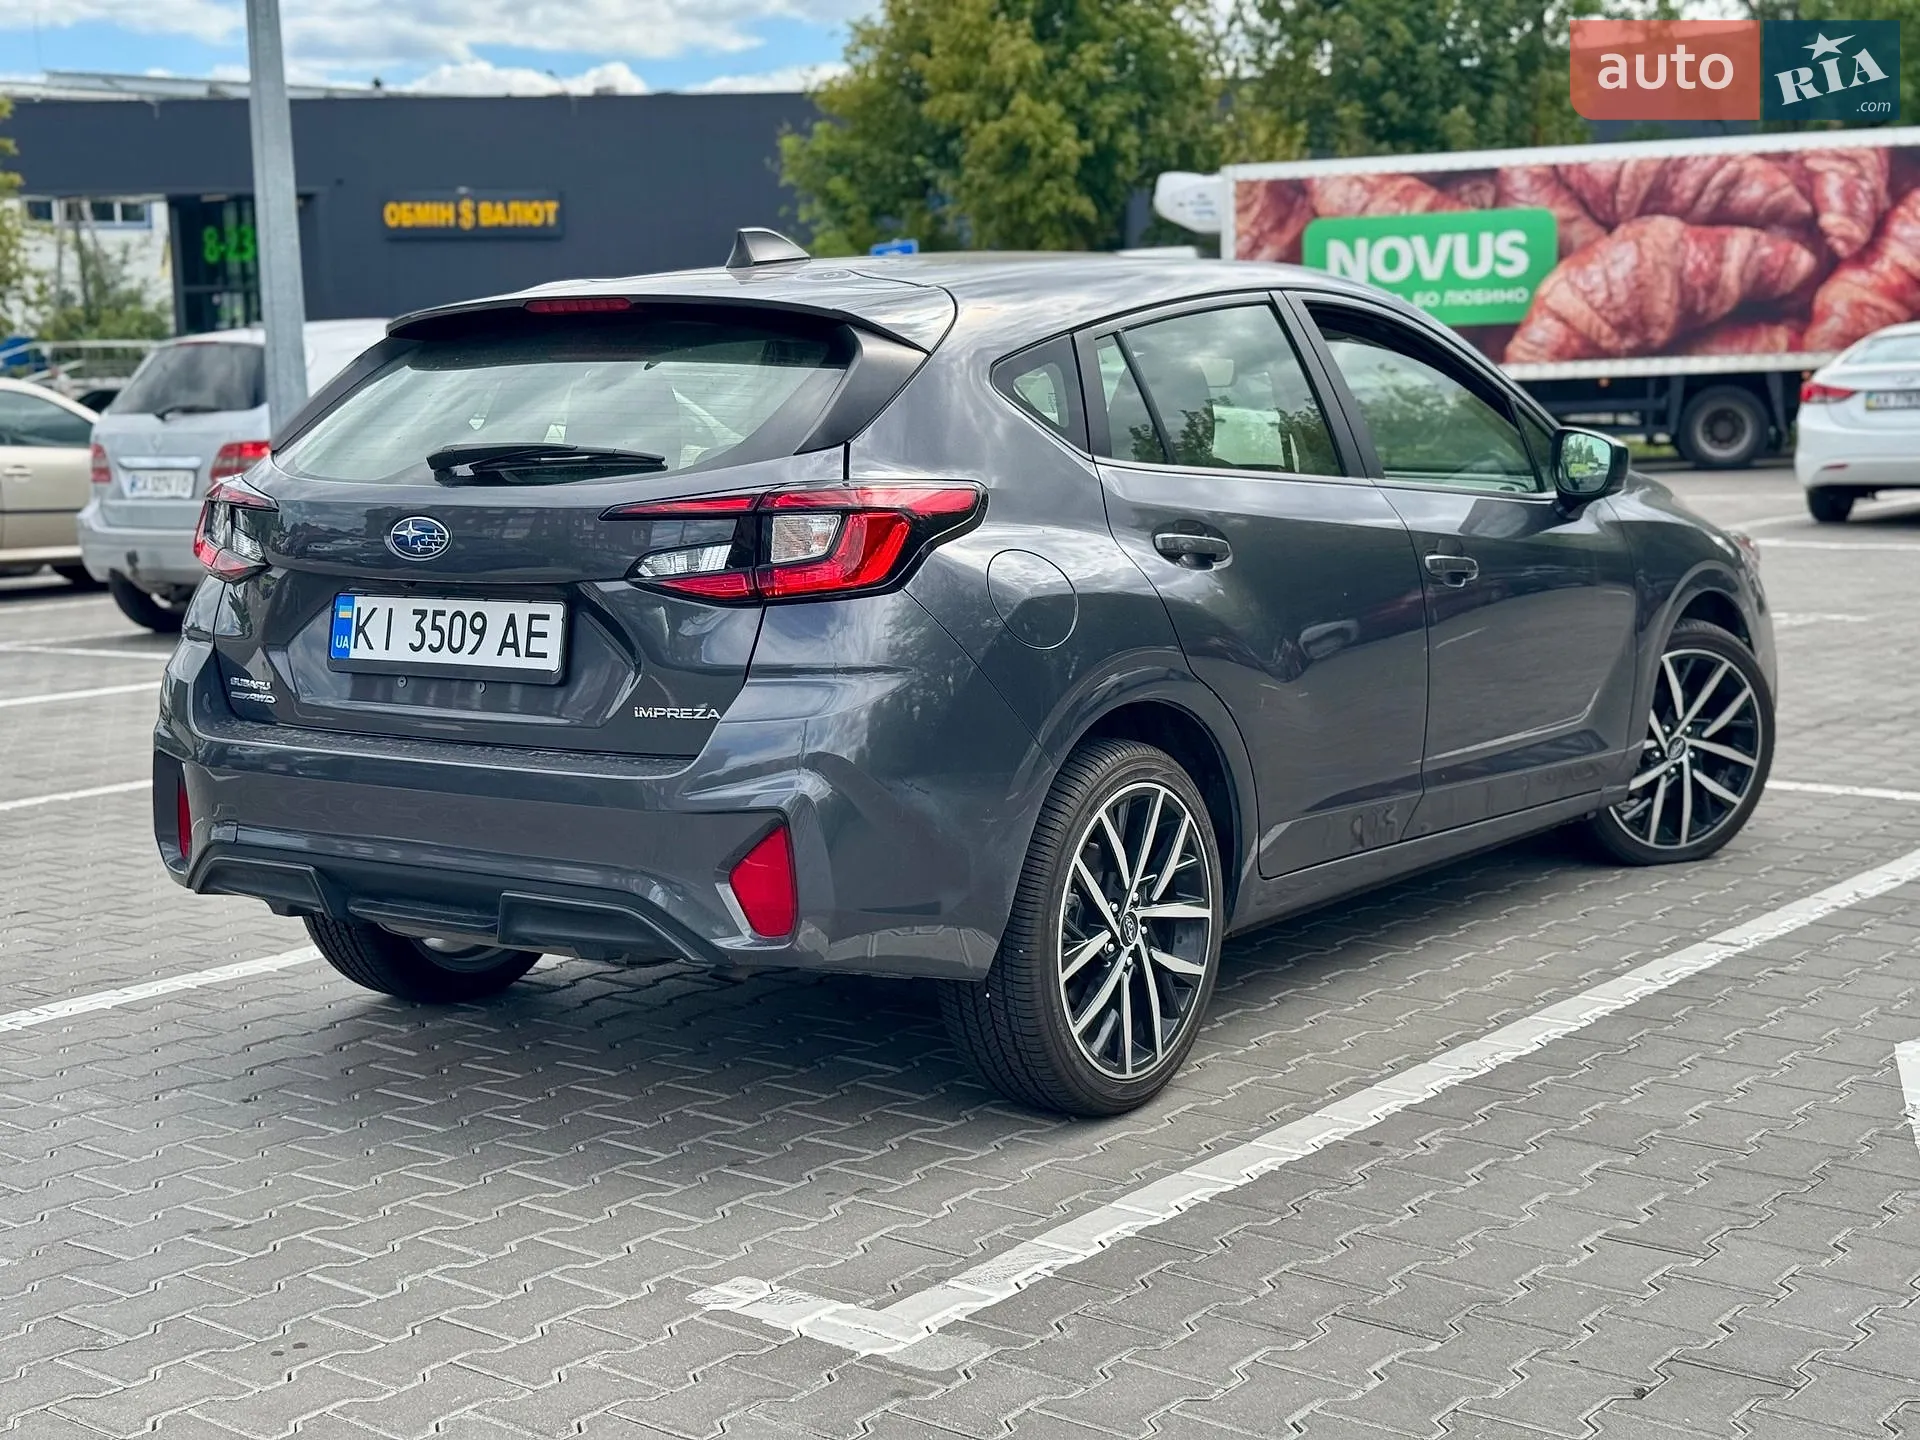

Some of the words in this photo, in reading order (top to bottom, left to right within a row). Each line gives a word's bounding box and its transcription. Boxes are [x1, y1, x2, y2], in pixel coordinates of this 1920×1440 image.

[383, 201, 457, 229] ОБМІН
[477, 200, 560, 228] ВАЛЮТ
[1326, 229, 1530, 284] NOVUS
[335, 635, 350, 649] UA
[353, 606, 394, 652] KI
[408, 608, 489, 656] 3509
[496, 612, 551, 659] AE
[230, 676, 272, 691] SUBARU
[634, 706, 721, 719] IMPREZA
